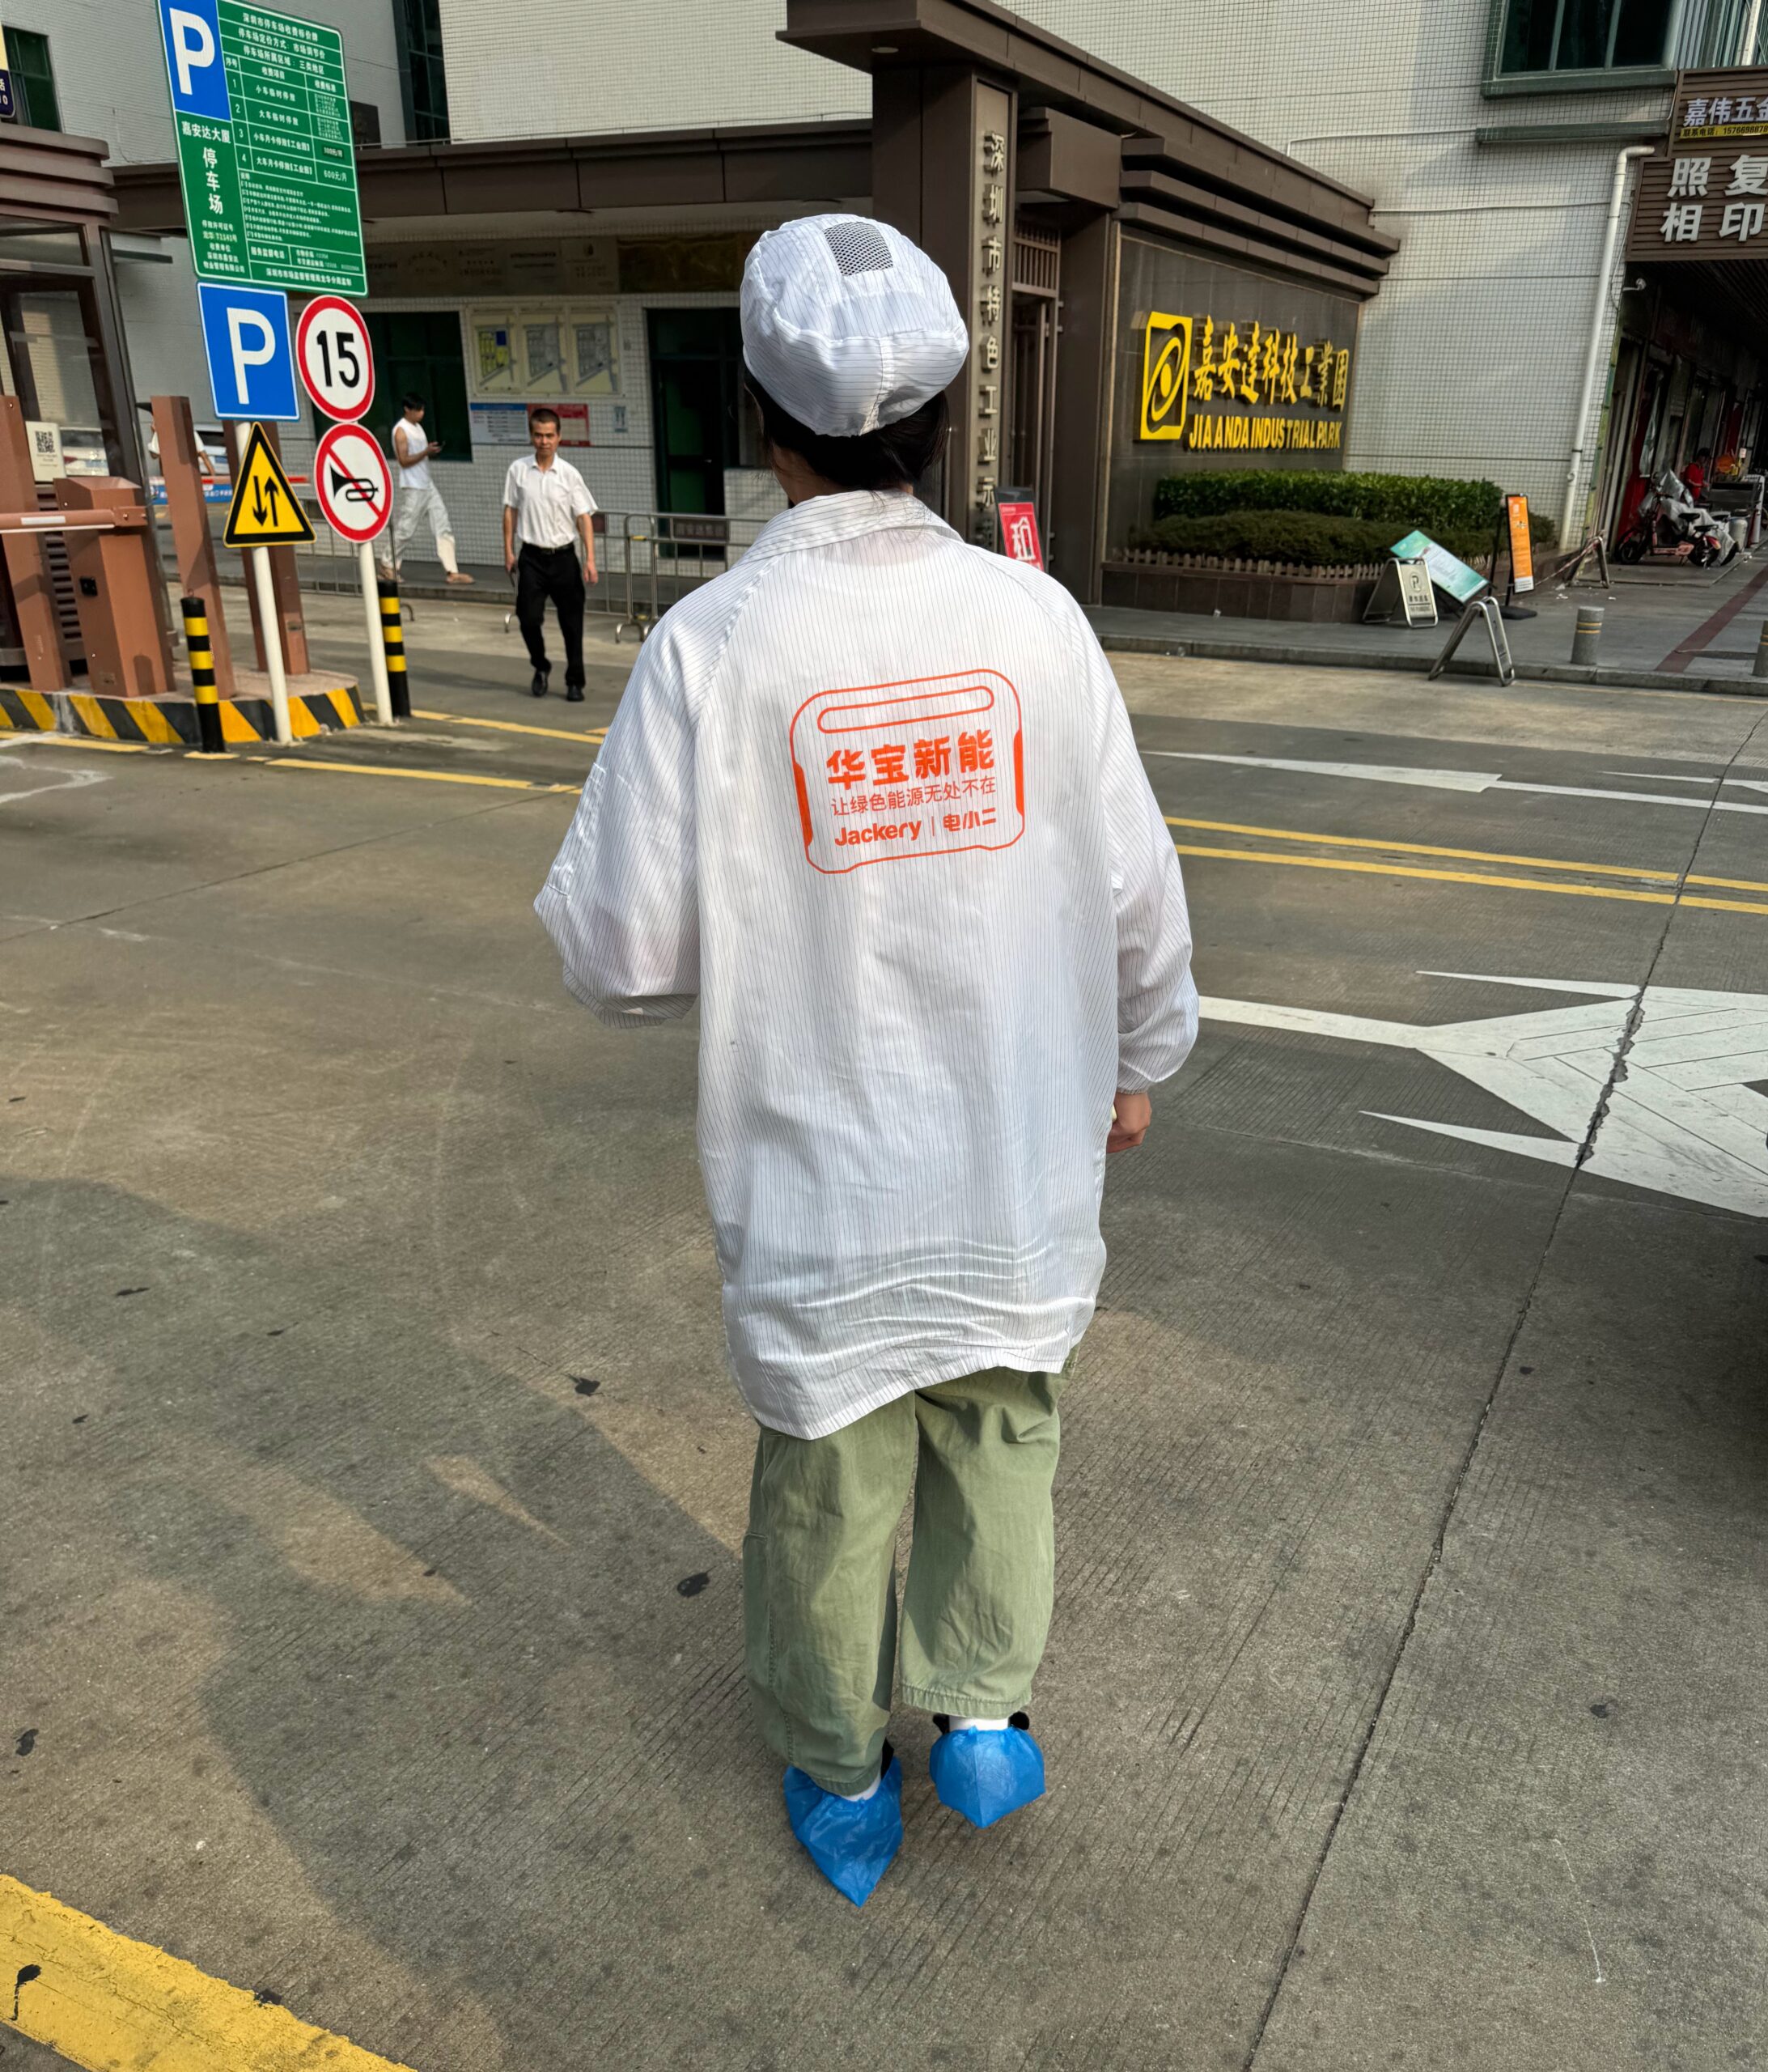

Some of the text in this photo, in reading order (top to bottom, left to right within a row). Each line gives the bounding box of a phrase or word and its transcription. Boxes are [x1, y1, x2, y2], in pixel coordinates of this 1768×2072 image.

[169, 7, 216, 96] P
[232, 79, 237, 88] 1
[235, 103, 241, 113] 2
[181, 121, 231, 144] 嘉安达大厦
[239, 128, 244, 138] 3
[241, 153, 247, 162] 4
[203, 146, 223, 214] 停车场
[227, 308, 276, 405] P
[316, 331, 360, 388] 15
[1251, 417, 1316, 448] INDUSTRIAL
[1316, 421, 1342, 448] PARK
[826, 728, 994, 790] 华宝新能
[830, 775, 996, 817] 让绿色能源无处不在
[834, 807, 997, 847] Jackery 电小二
